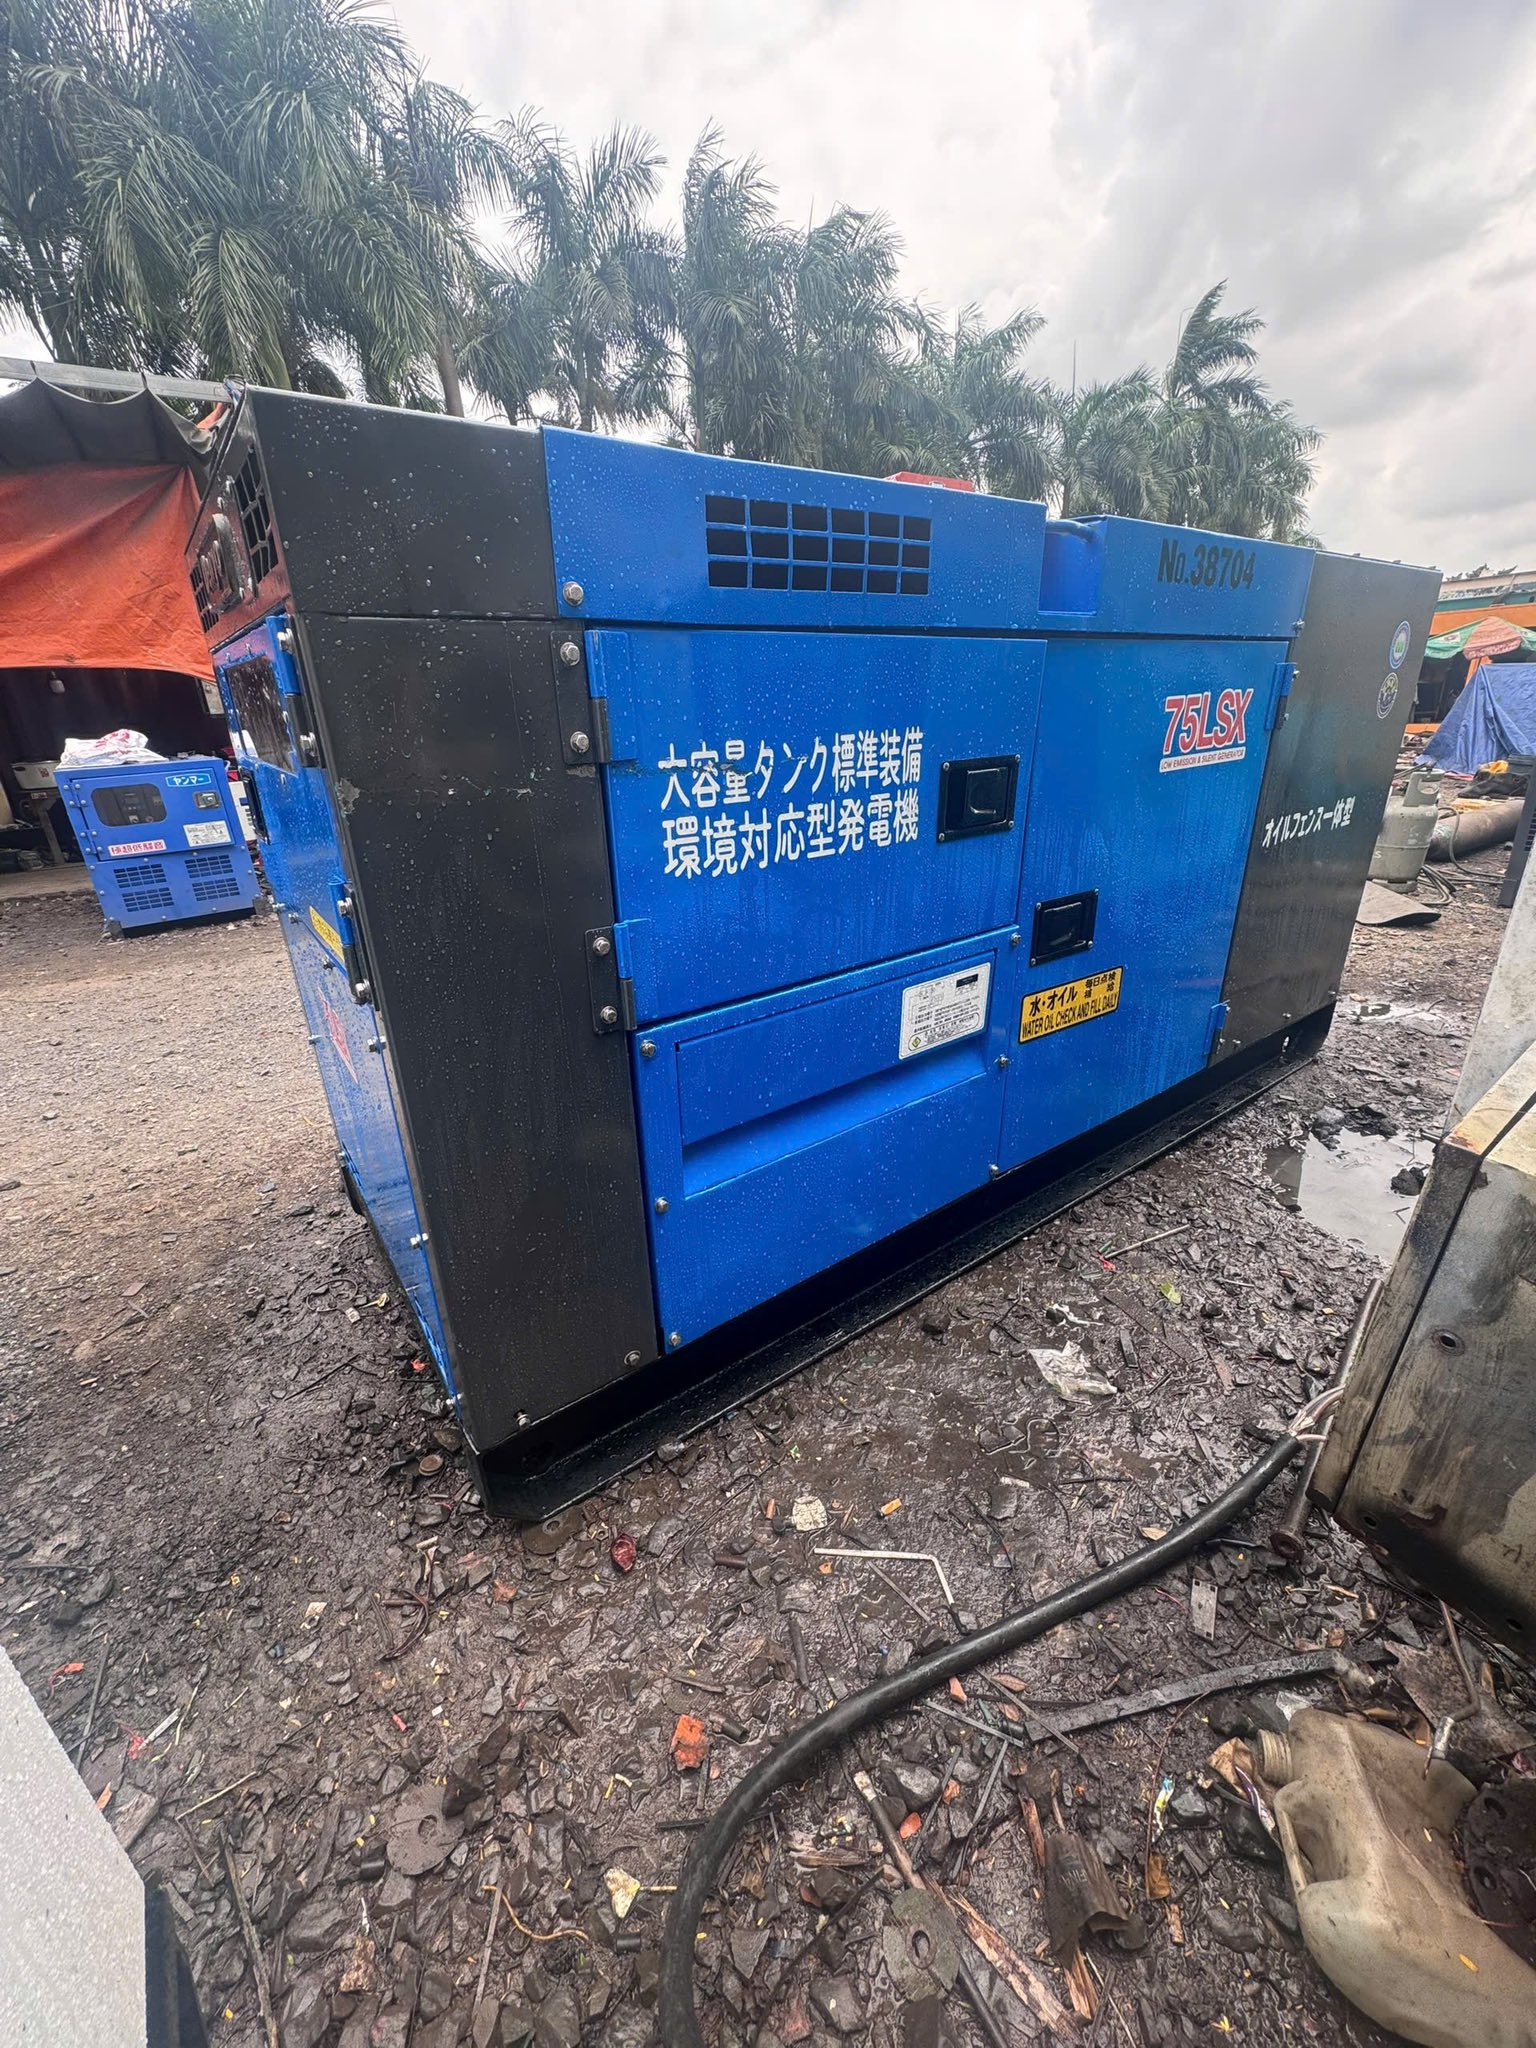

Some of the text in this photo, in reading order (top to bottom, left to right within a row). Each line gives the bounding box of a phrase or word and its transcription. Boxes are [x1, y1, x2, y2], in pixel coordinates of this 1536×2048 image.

[1157, 538, 1256, 590] No.38704
[1163, 688, 1254, 755] 75LSX
[173, 775, 204, 786] ヤンマー
[658, 726, 924, 810] 大容量タンク標準装備
[1173, 757, 1197, 768] EMISSION
[1201, 753, 1217, 764] SILENT
[661, 788, 919, 880] 環境対応型発電機
[1022, 993, 1118, 1038] WATER OIL CHECK AND FILL DAILY
[1029, 985, 1078, 1017] 水・オイル
